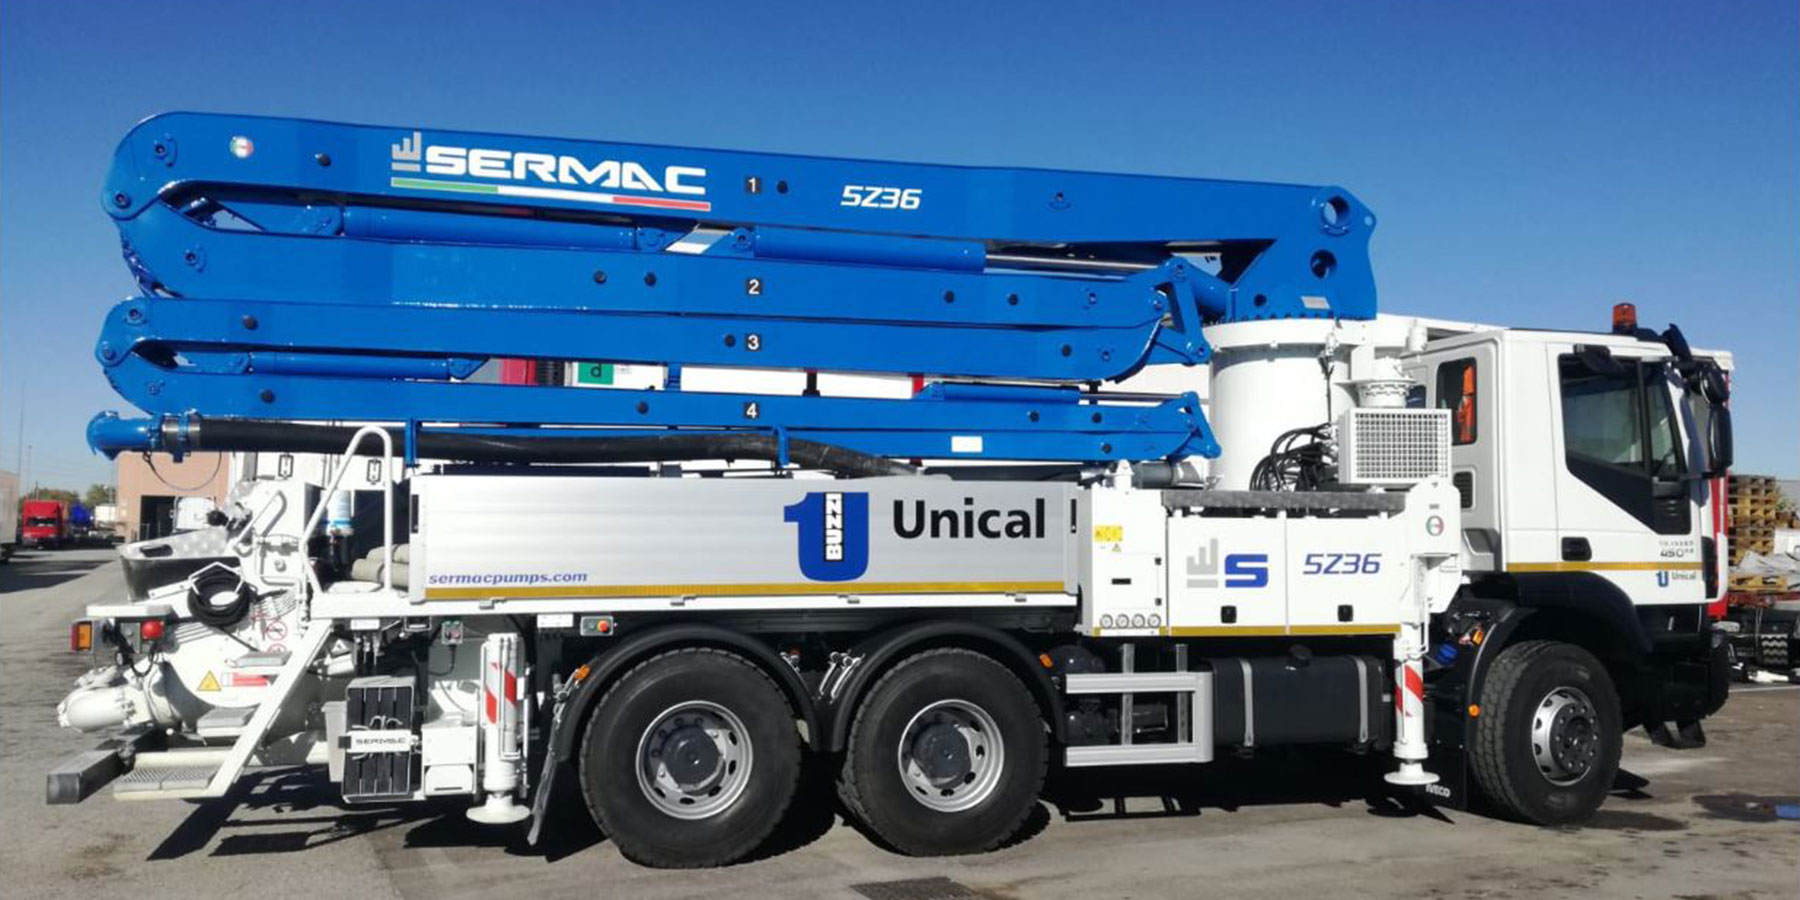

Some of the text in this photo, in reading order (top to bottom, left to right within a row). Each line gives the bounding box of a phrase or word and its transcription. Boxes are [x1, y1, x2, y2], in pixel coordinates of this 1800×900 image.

[426, 145, 706, 195] SERMAC
[748, 177, 757, 193] 1
[748, 279, 760, 295] 2
[748, 334, 759, 351] 3
[746, 402, 757, 419] 4
[893, 497, 1045, 538] Unical
[824, 492, 843, 561] BUZZI
[428, 572, 588, 585] sermacpumps.com
[1671, 571, 1696, 580] Unical
[1426, 784, 1451, 798] IVECO
